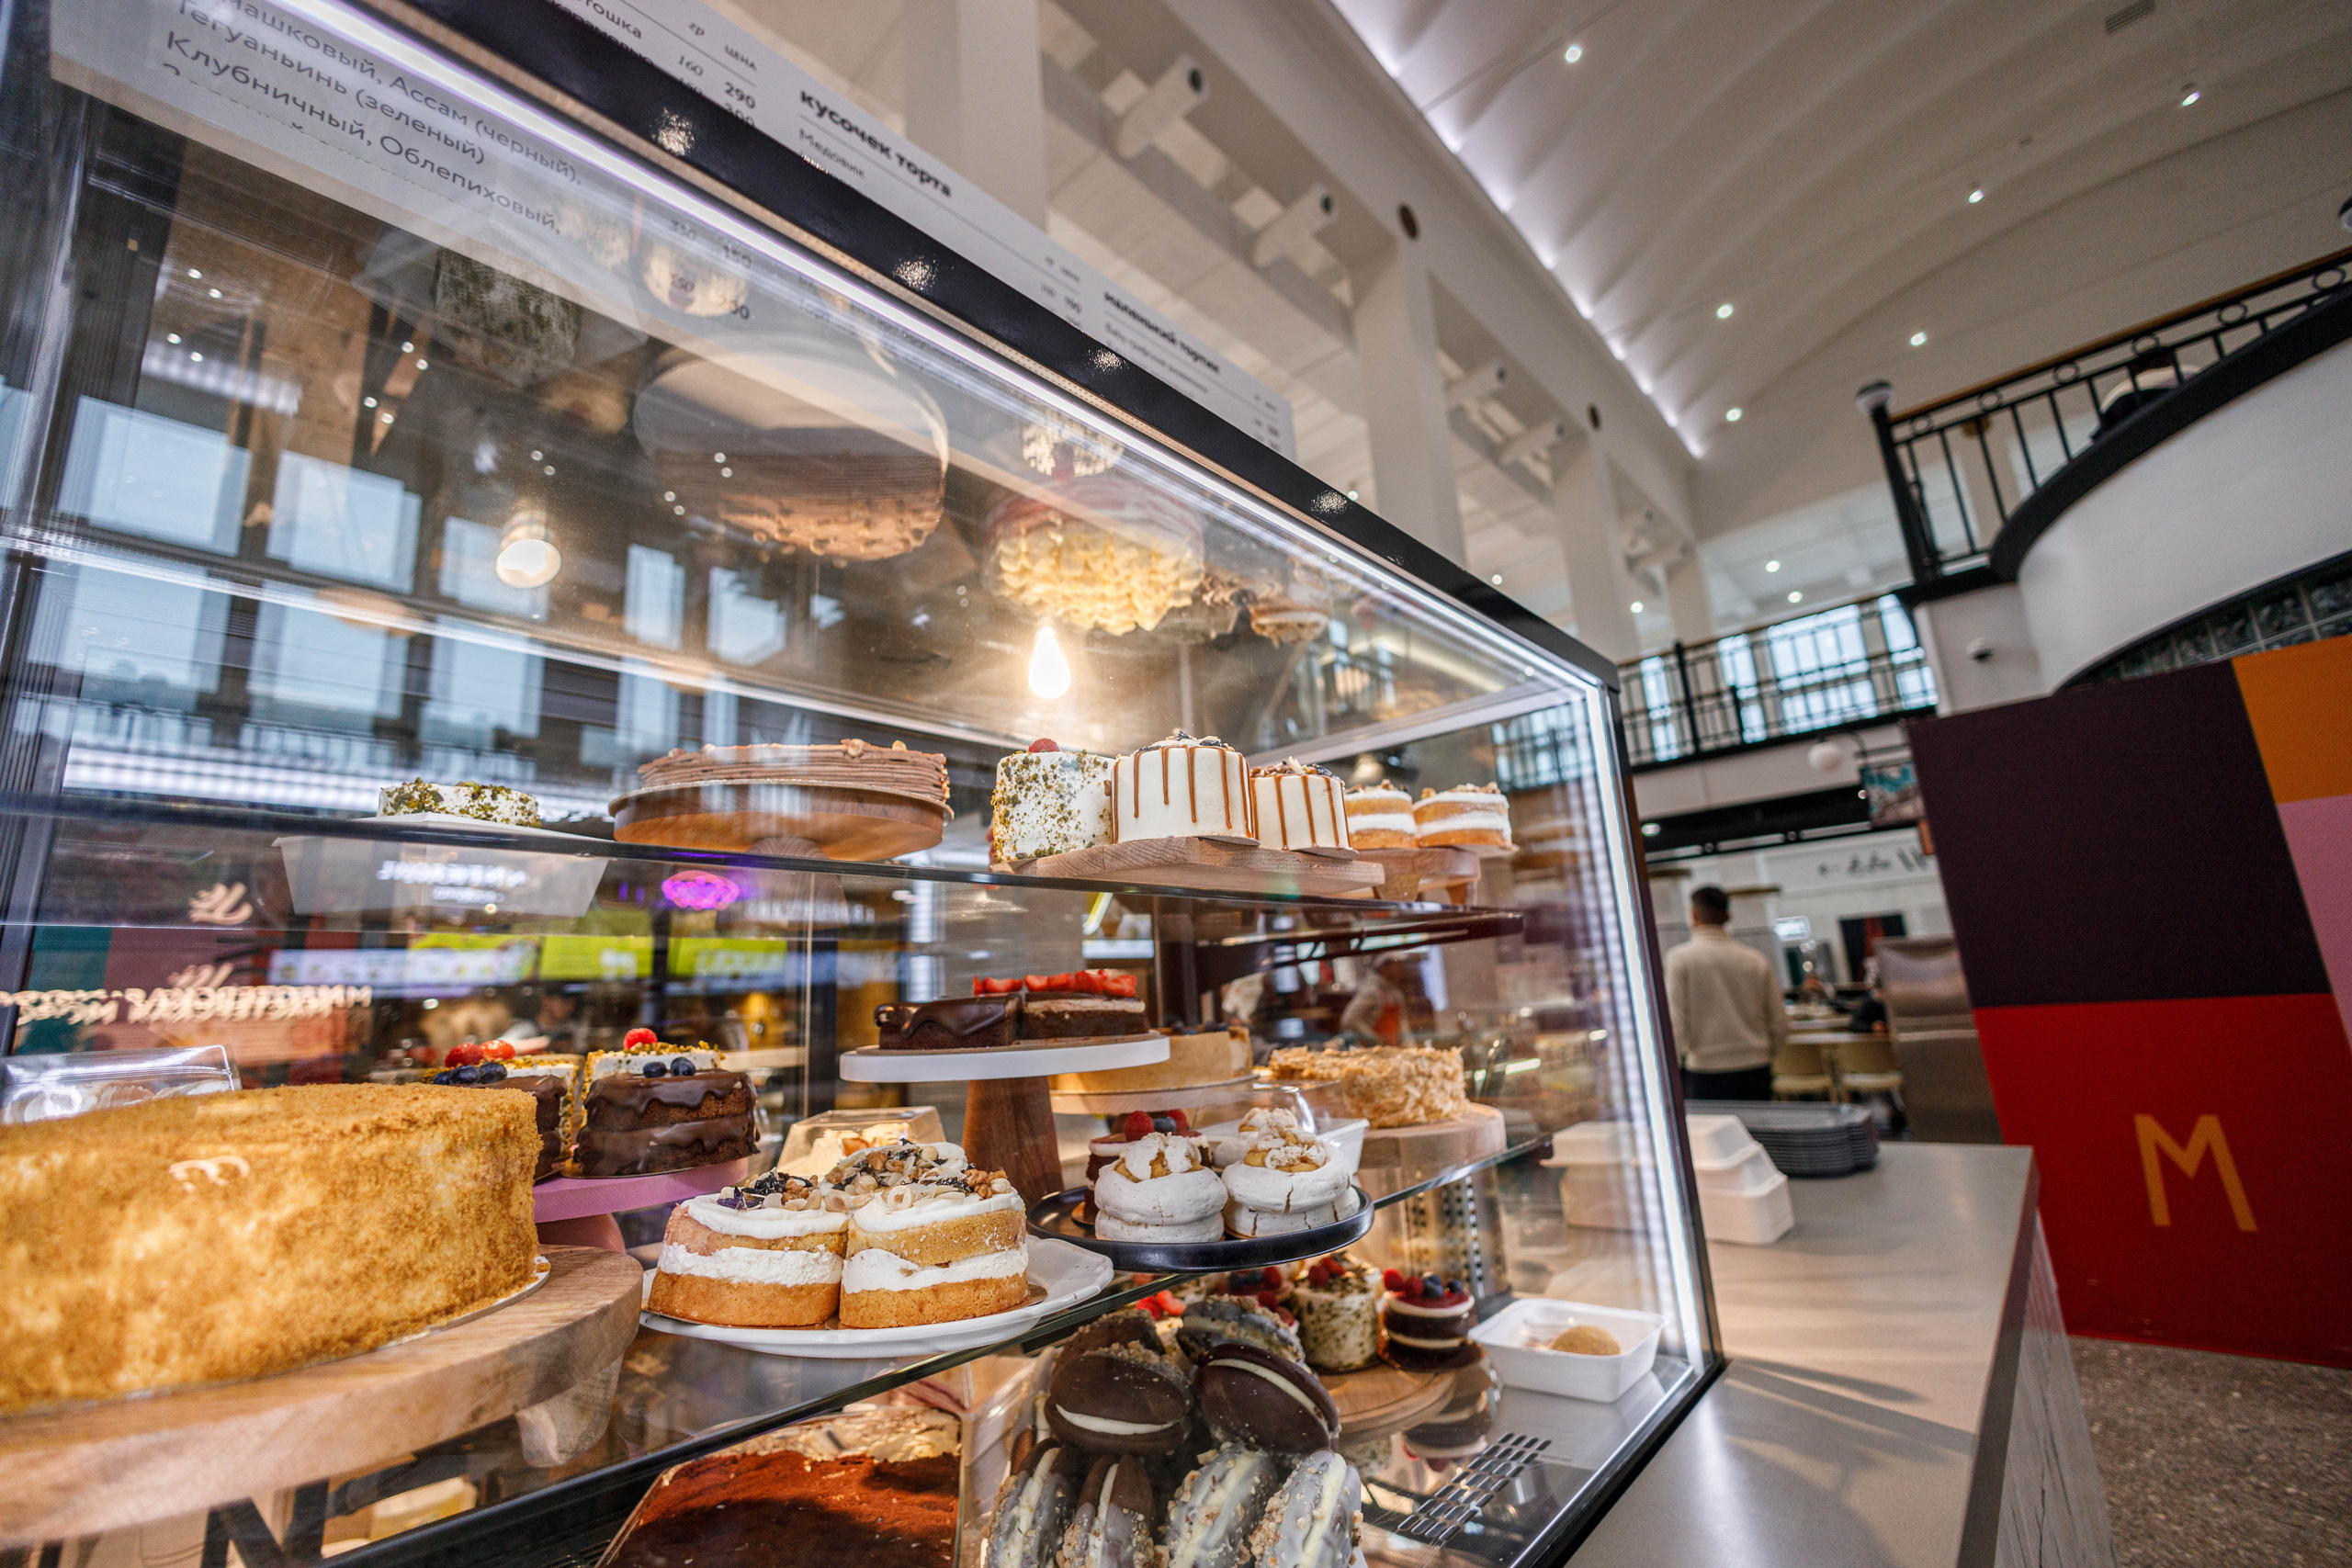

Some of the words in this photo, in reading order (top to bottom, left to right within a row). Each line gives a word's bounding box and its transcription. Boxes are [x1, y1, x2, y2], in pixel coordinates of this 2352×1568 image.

[677, 55, 705, 77] 160
[723, 82, 756, 109] 290
[724, 44, 758, 72] ЦЕНА
[356, 89, 485, 165] (зеленый)
[390, 75, 469, 126] Ассам
[166, 30, 372, 147] Клубничный,
[380, 135, 561, 235] Облепиховый,
[798, 127, 866, 180] Медовик
[895, 152, 953, 198] торта
